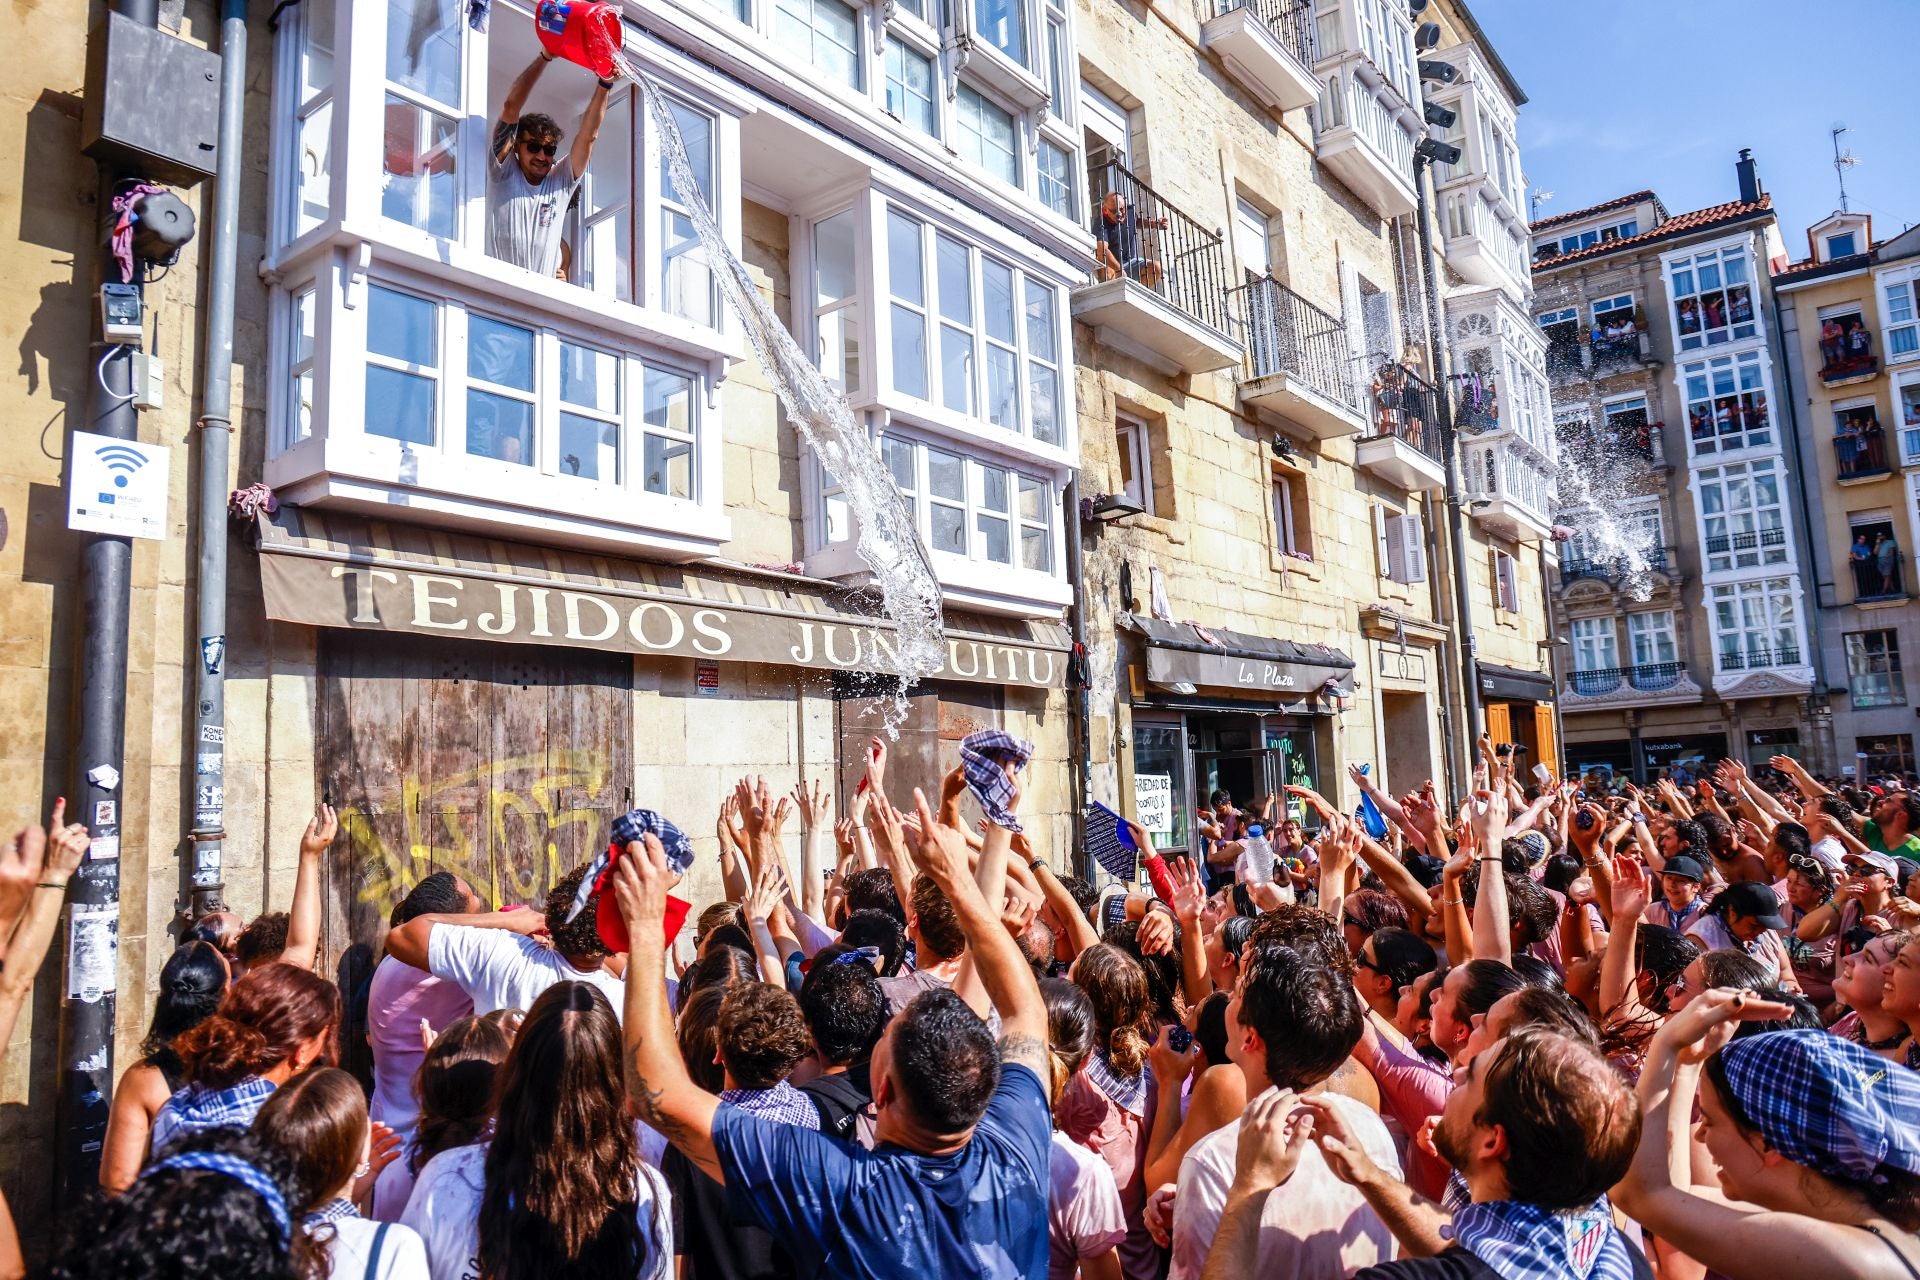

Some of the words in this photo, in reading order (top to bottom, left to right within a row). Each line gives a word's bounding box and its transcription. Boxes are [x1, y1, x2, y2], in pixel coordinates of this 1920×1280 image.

[331, 566, 732, 655] TEJIDOS
[791, 622, 1053, 685] JUNUITU
[1238, 662, 1254, 683] La
[1263, 664, 1295, 686] Plaza
[1645, 742, 1683, 751] kutxabank
[1648, 754, 1657, 765] k
[1134, 778, 1160, 792] ARIEDAD
[1160, 778, 1169, 790] DE
